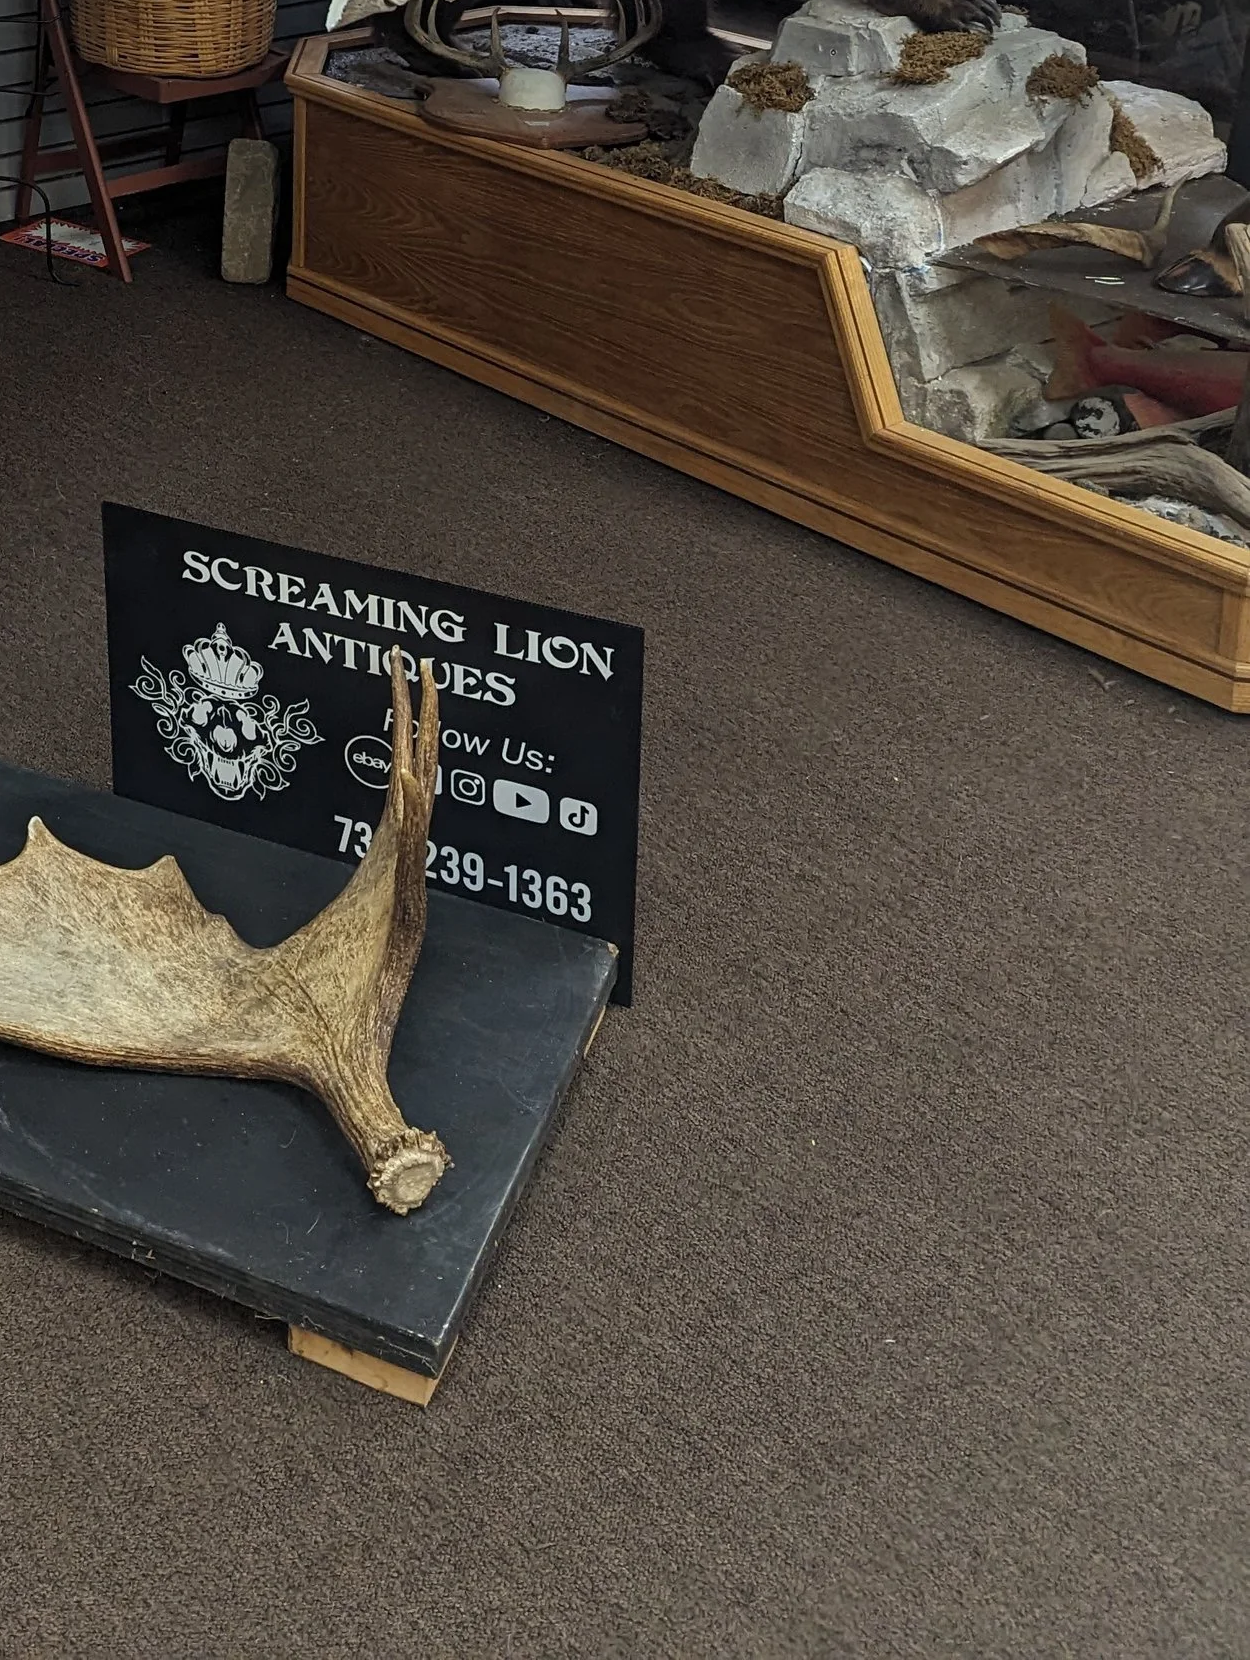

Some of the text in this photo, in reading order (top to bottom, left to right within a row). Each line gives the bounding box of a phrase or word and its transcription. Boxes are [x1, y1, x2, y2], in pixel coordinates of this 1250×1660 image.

[182, 550, 615, 682] SCREAMING LION
[267, 622, 517, 707] ANTIQUES
[352, 751, 392, 773] ebay
[501, 737, 555, 774] Us:
